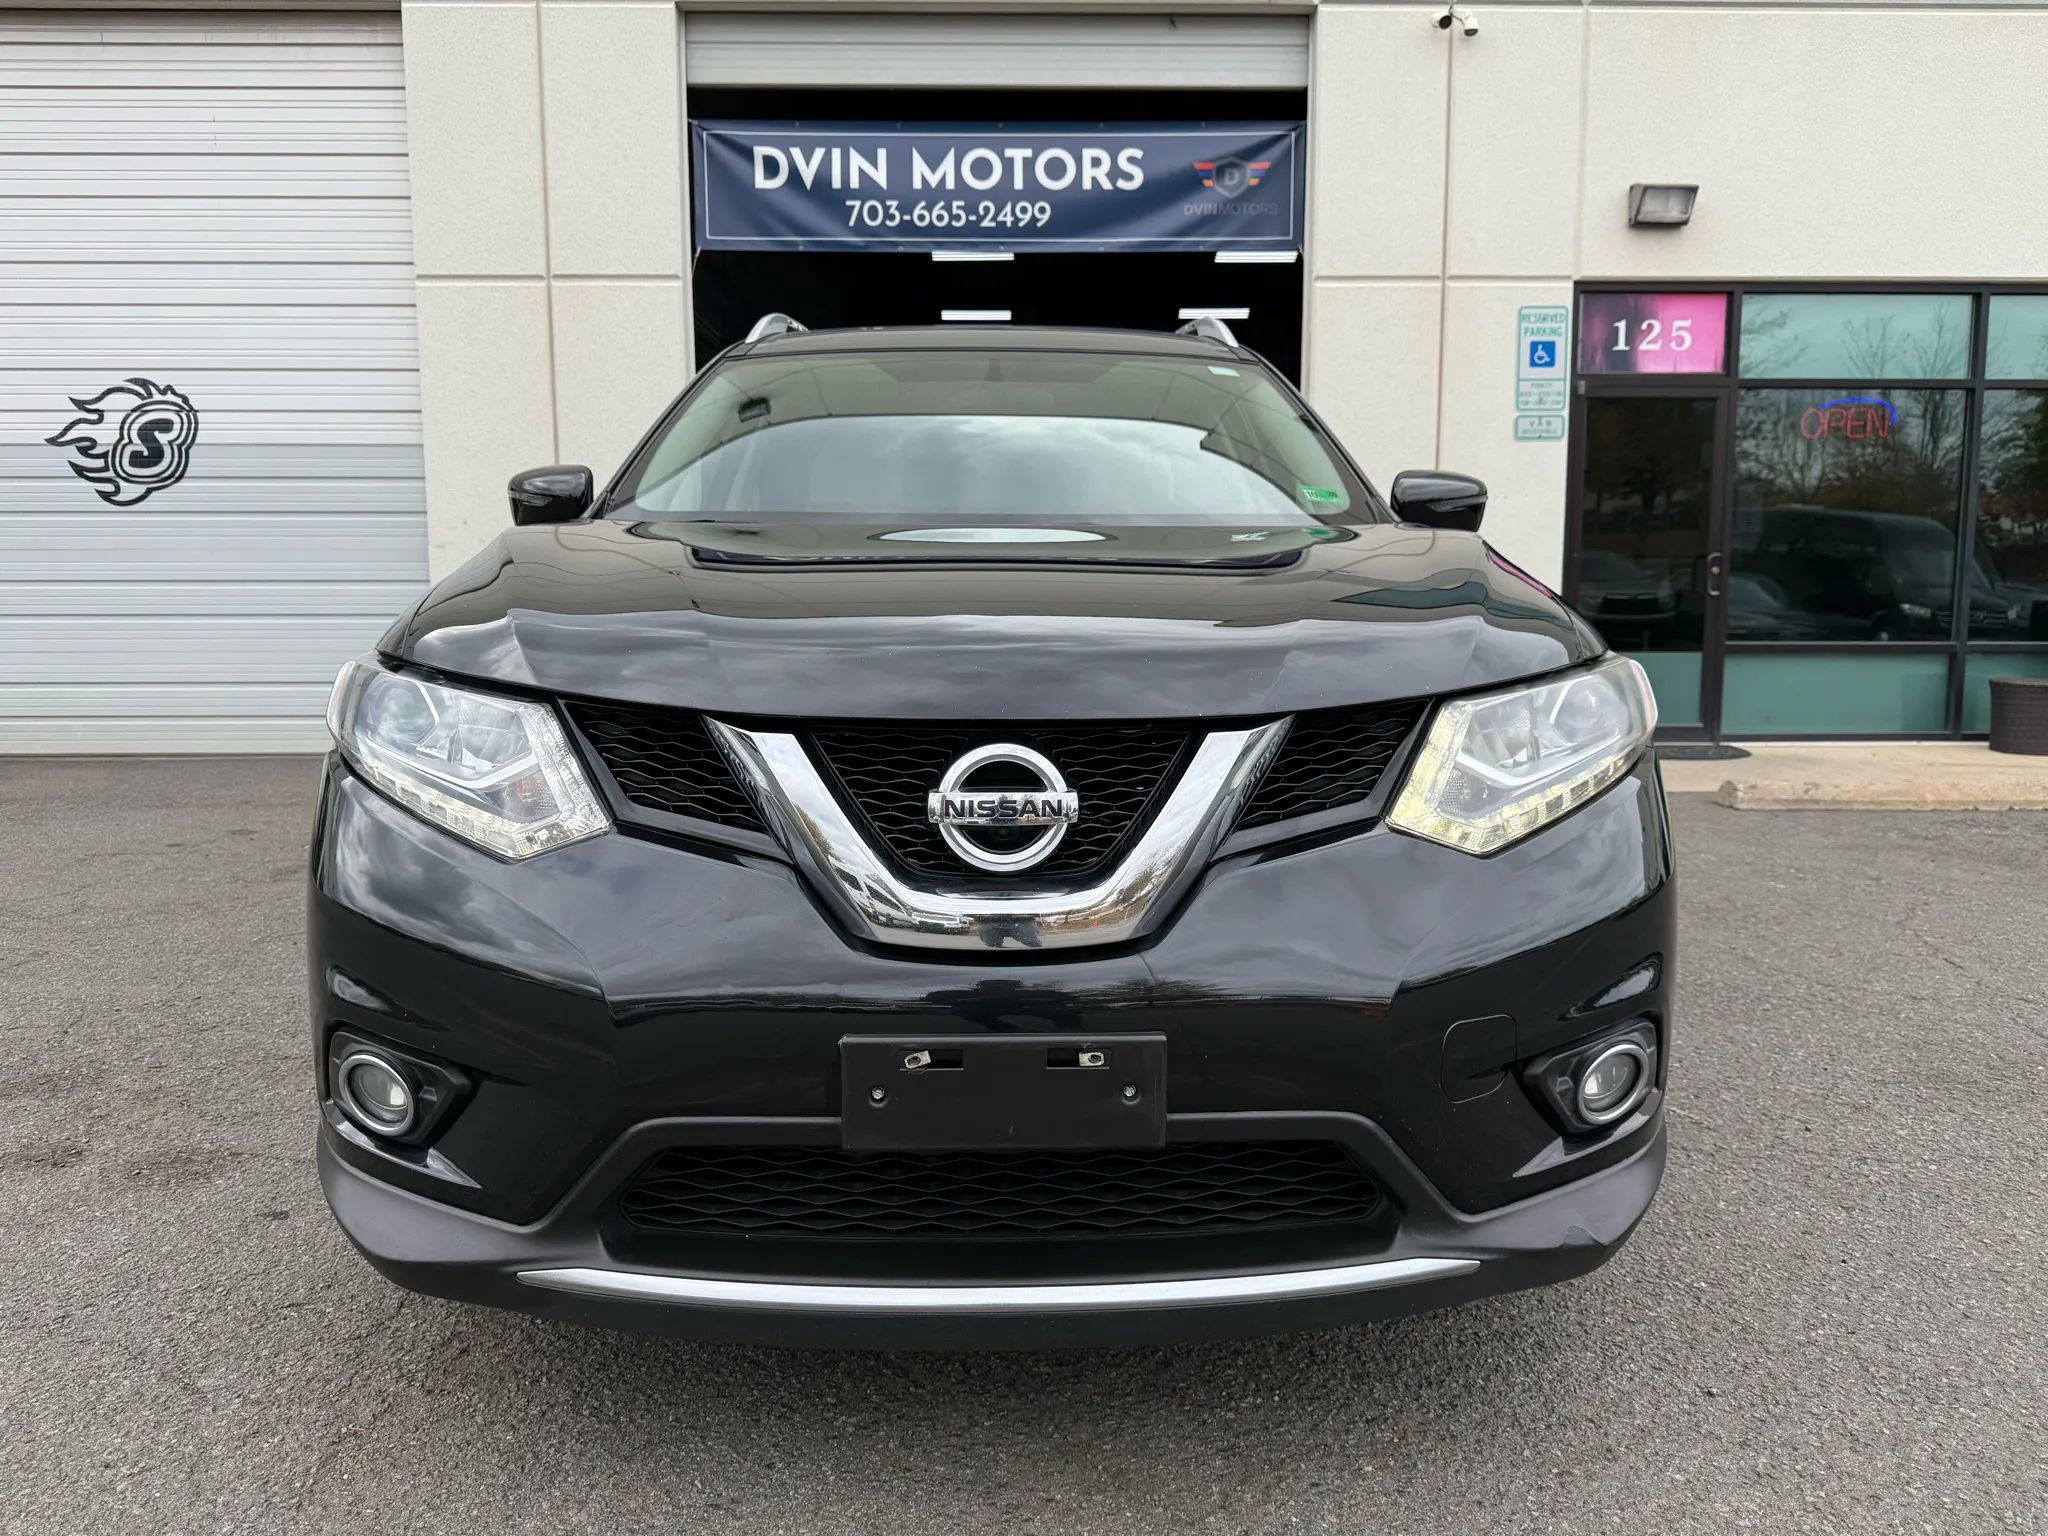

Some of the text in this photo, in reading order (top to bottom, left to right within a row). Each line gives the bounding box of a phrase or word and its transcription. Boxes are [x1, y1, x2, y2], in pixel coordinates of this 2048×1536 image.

[753, 146, 1144, 191] DVIN MOTORS
[846, 200, 1051, 227] 703-665-2499
[1523, 326, 1562, 337] PARKING
[1612, 319, 1693, 351] 125
[1801, 407, 1889, 440] OPEN
[944, 799, 1062, 818] NISSAN
